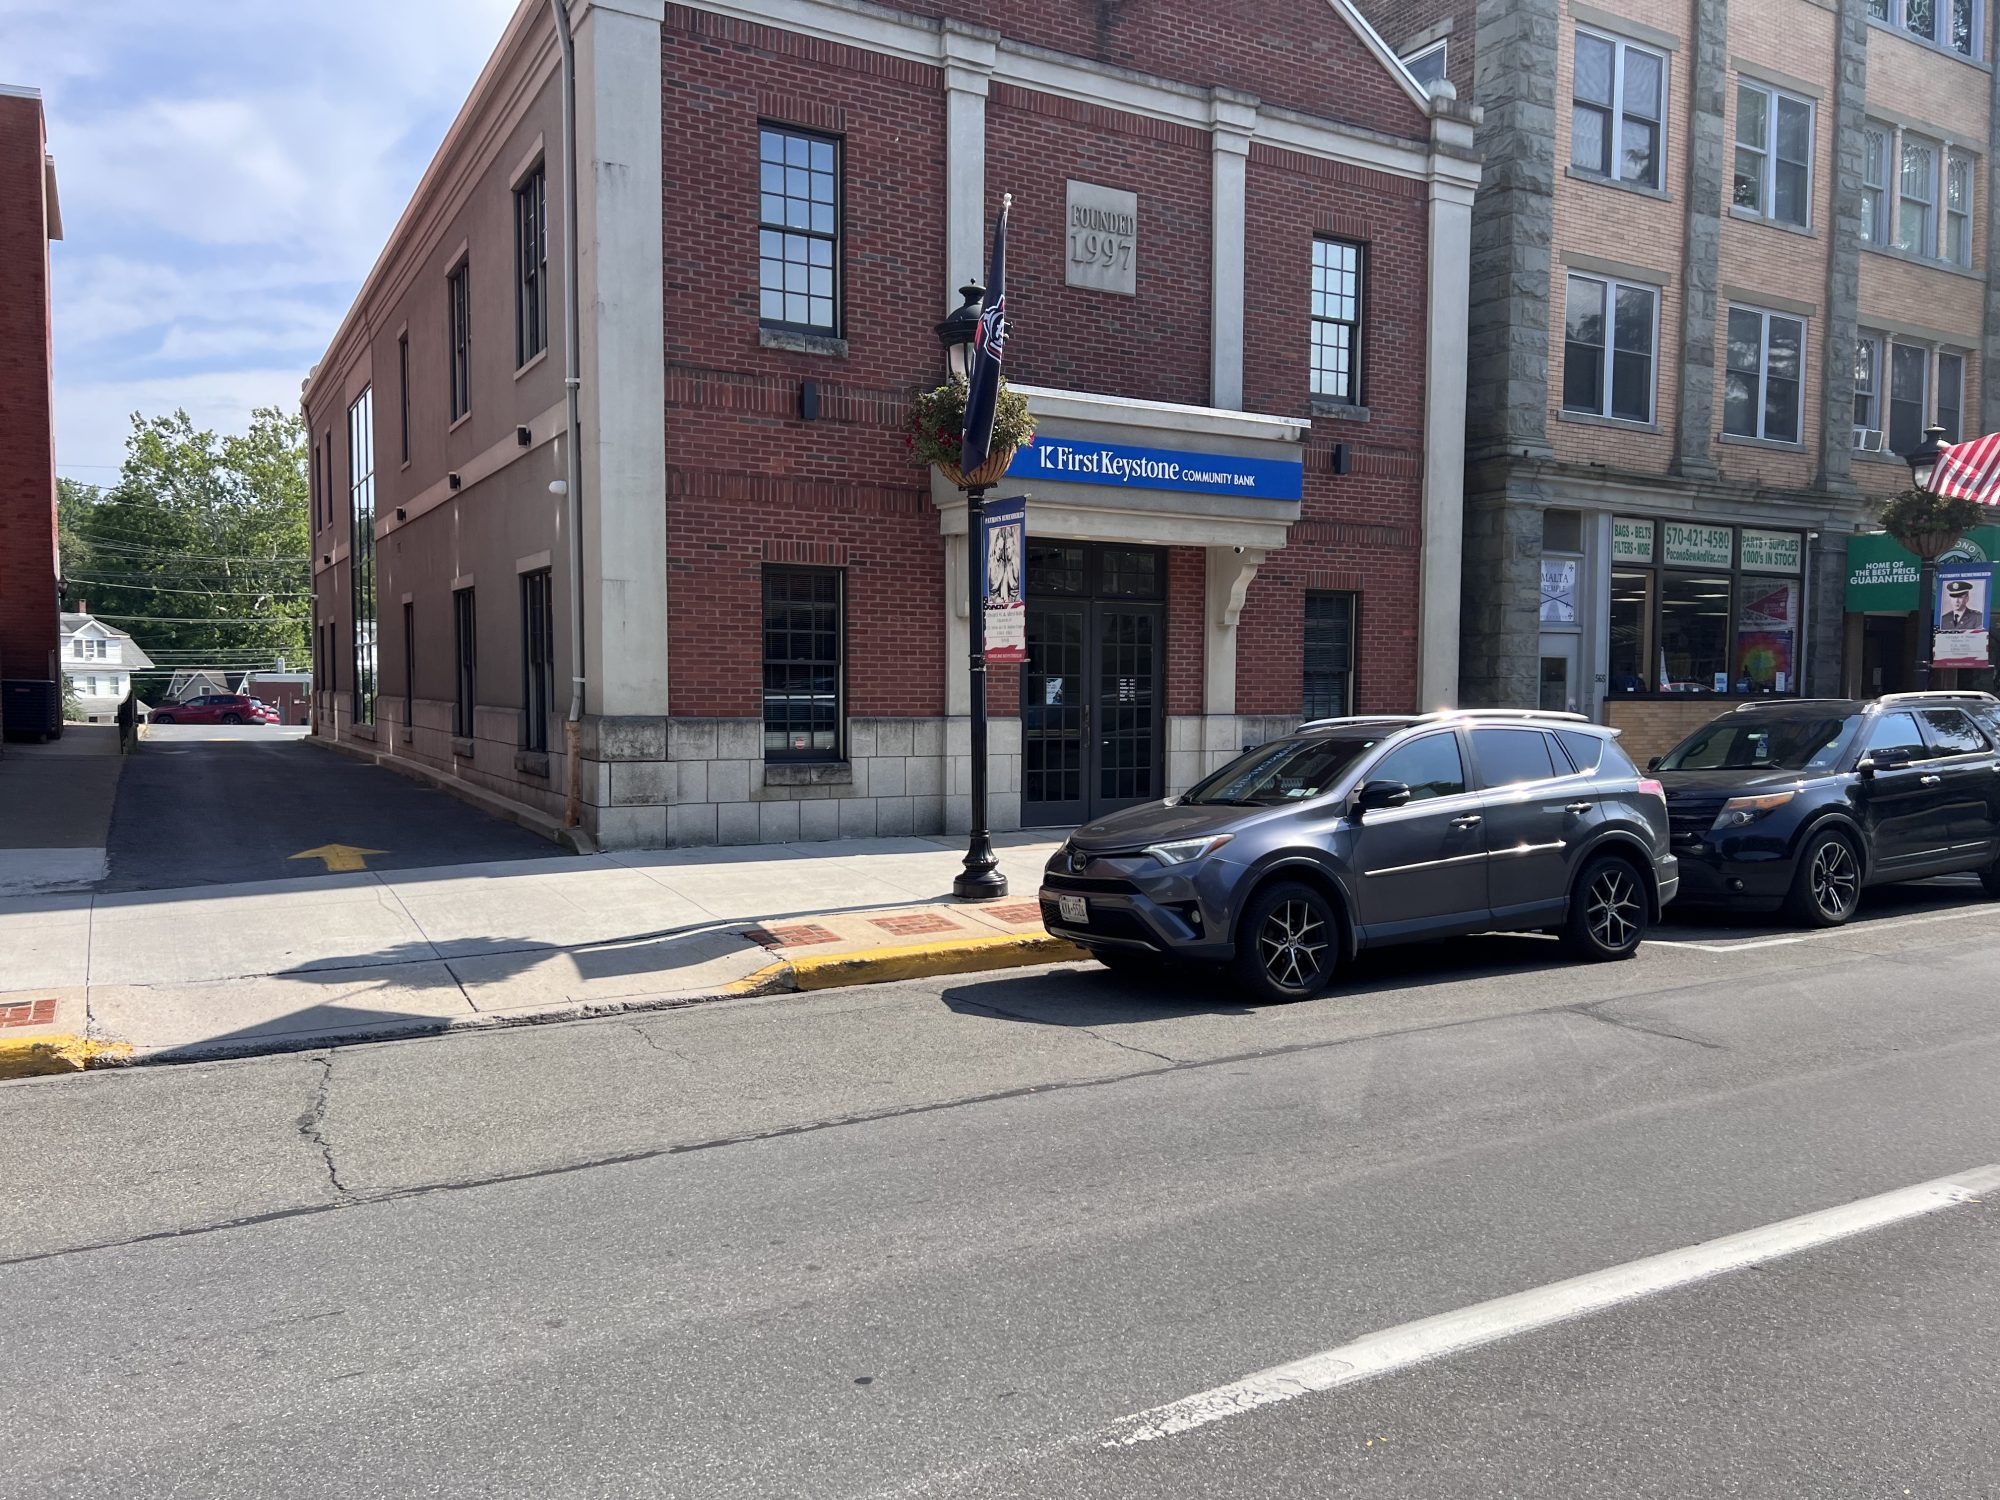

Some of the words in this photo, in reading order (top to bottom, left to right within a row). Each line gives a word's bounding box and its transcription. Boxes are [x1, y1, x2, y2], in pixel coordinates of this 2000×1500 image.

[1071, 205, 1135, 237] FOUNDED
[1070, 232, 1134, 271] 1997
[1182, 469, 1233, 485] COMMUNITY
[1233, 474, 1256, 487] BANK
[1614, 524, 1630, 538] BAGS
[1634, 526, 1652, 540] BELTS
[1665, 526, 1730, 549] 570-421-4580
[1614, 540, 1634, 555] FILTERS
[1742, 535, 1763, 549] PARTS
[1768, 537, 1800, 552] SUPPLIES
[1765, 551, 1773, 565] IN
[1774, 552, 1797, 567] STOCK
[1865, 562, 1890, 570] HOME
[1541, 573, 1569, 583] MALTA
[1849, 573, 1920, 585] GUARANTEED!
[1855, 569, 1870, 577] THE
[1871, 568, 1890, 576] BEST
[1892, 567, 1915, 575] PRICE
